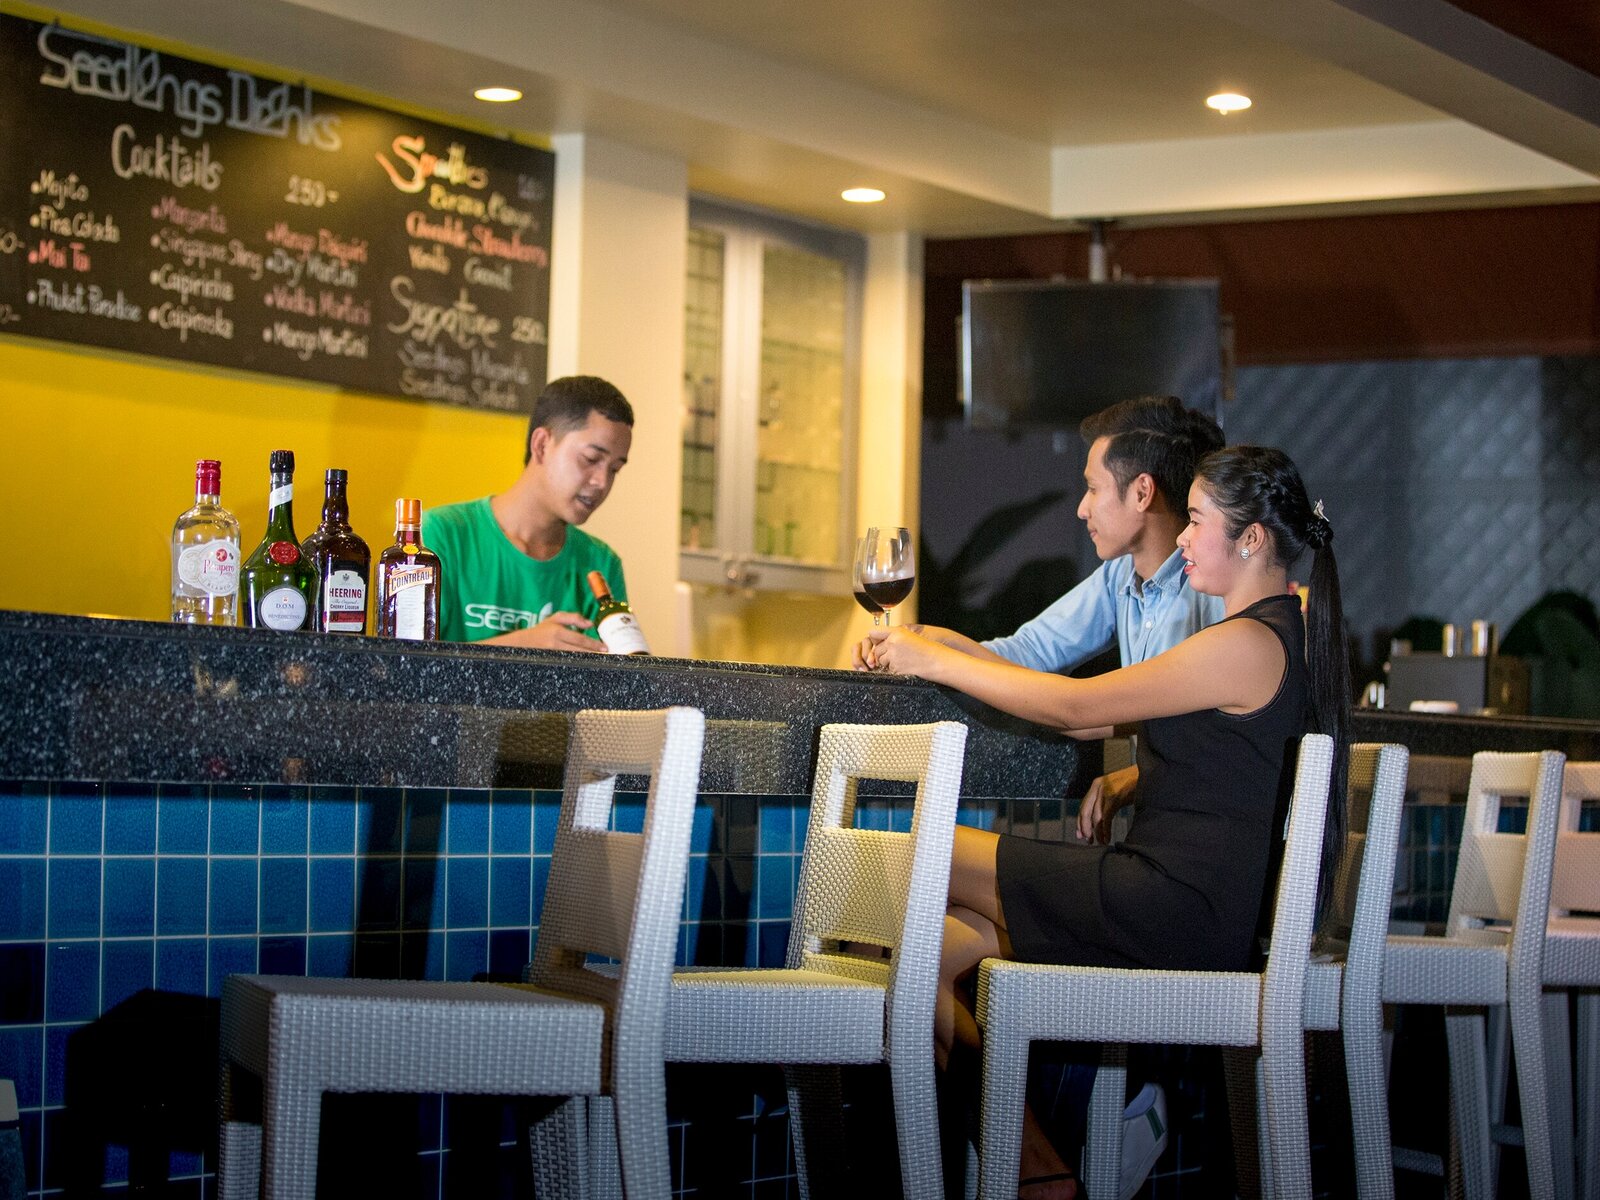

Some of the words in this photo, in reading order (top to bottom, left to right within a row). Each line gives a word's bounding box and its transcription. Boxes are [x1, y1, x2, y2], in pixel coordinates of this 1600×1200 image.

[111, 123, 224, 191] Cocktails
[38, 240, 67, 269] Mai
[203, 559, 235, 576] Pmpero
[391, 570, 430, 592] COINTREAU
[328, 587, 363, 599] HEERING
